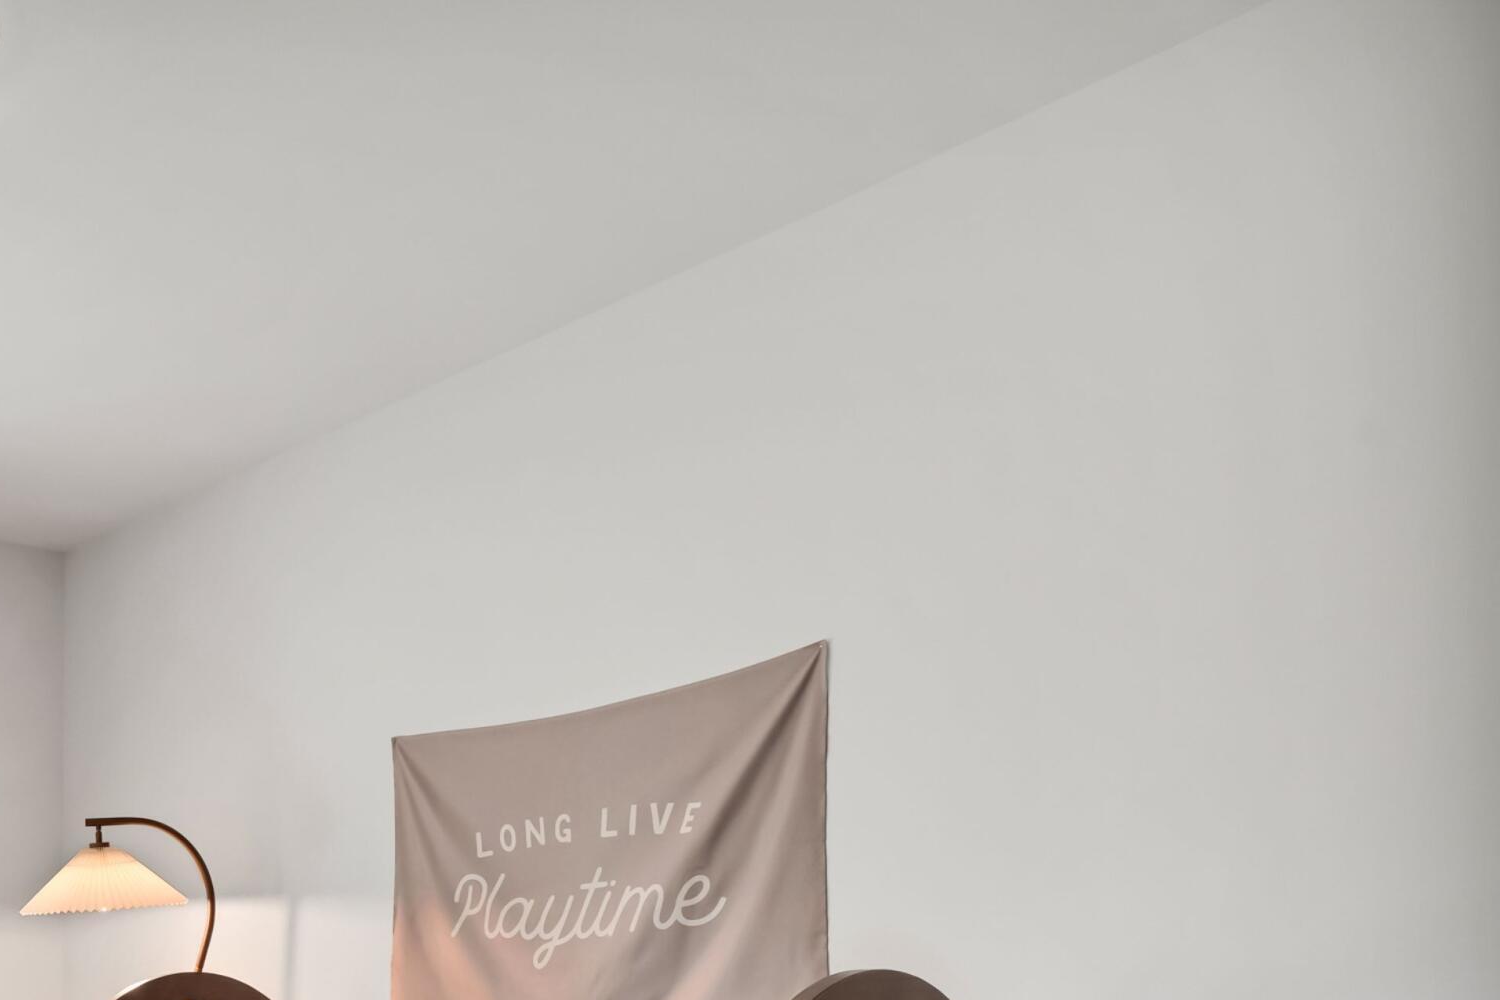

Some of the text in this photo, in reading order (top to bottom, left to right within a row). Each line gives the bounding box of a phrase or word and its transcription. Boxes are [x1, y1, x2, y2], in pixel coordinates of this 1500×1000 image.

[475, 801, 702, 858] LONG LIVE
[451, 866, 726, 969] Playtime
